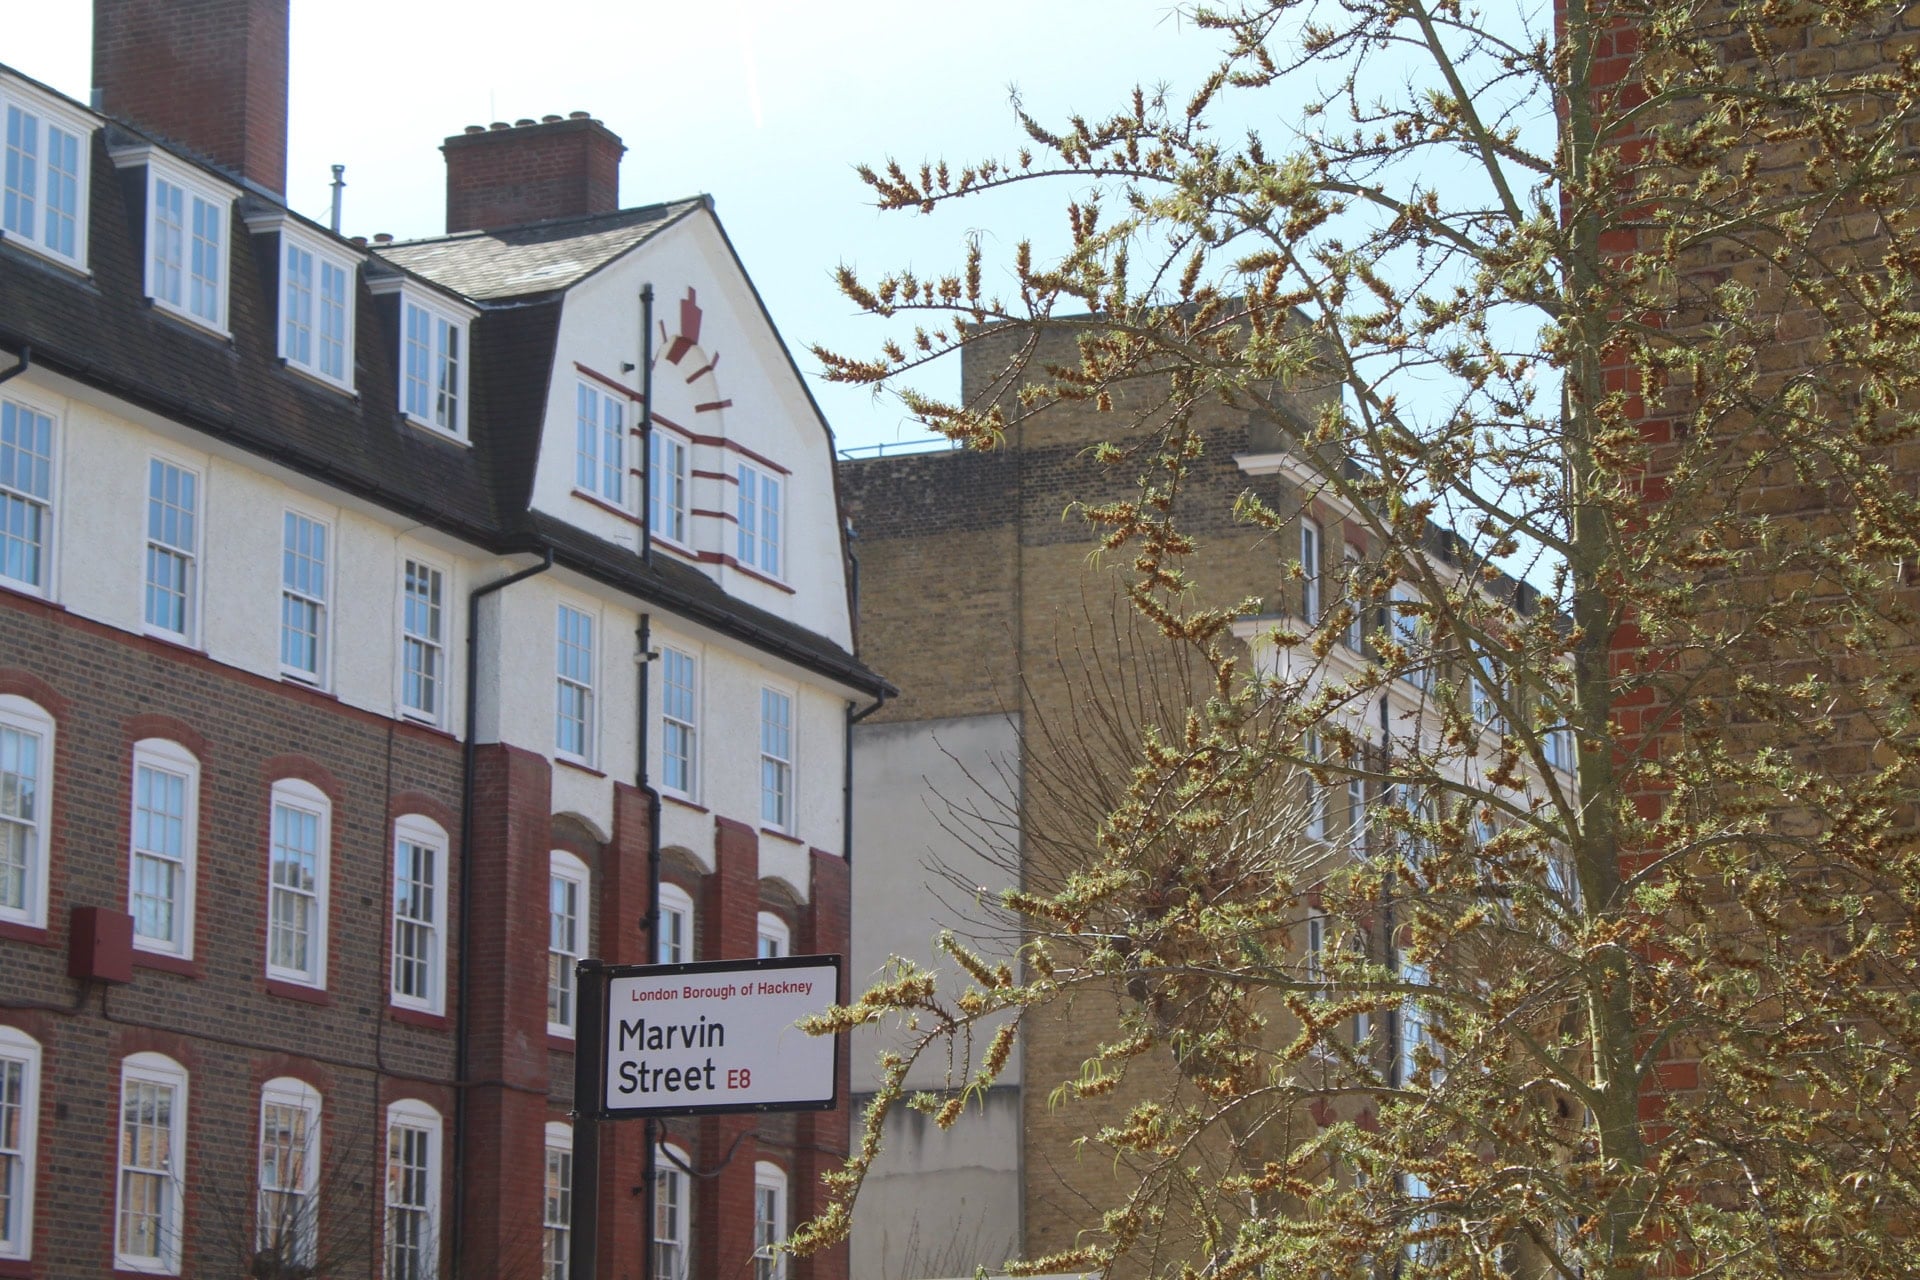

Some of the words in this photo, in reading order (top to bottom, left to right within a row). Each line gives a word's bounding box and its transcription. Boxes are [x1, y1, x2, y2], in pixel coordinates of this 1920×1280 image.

[633, 989, 677, 1001] London
[683, 985, 735, 1000] Borough
[741, 983, 753, 995] of
[759, 982, 812, 995] Hackney
[619, 1016, 724, 1051] Marvin
[619, 1058, 715, 1093] Street
[728, 1069, 750, 1088] E8
